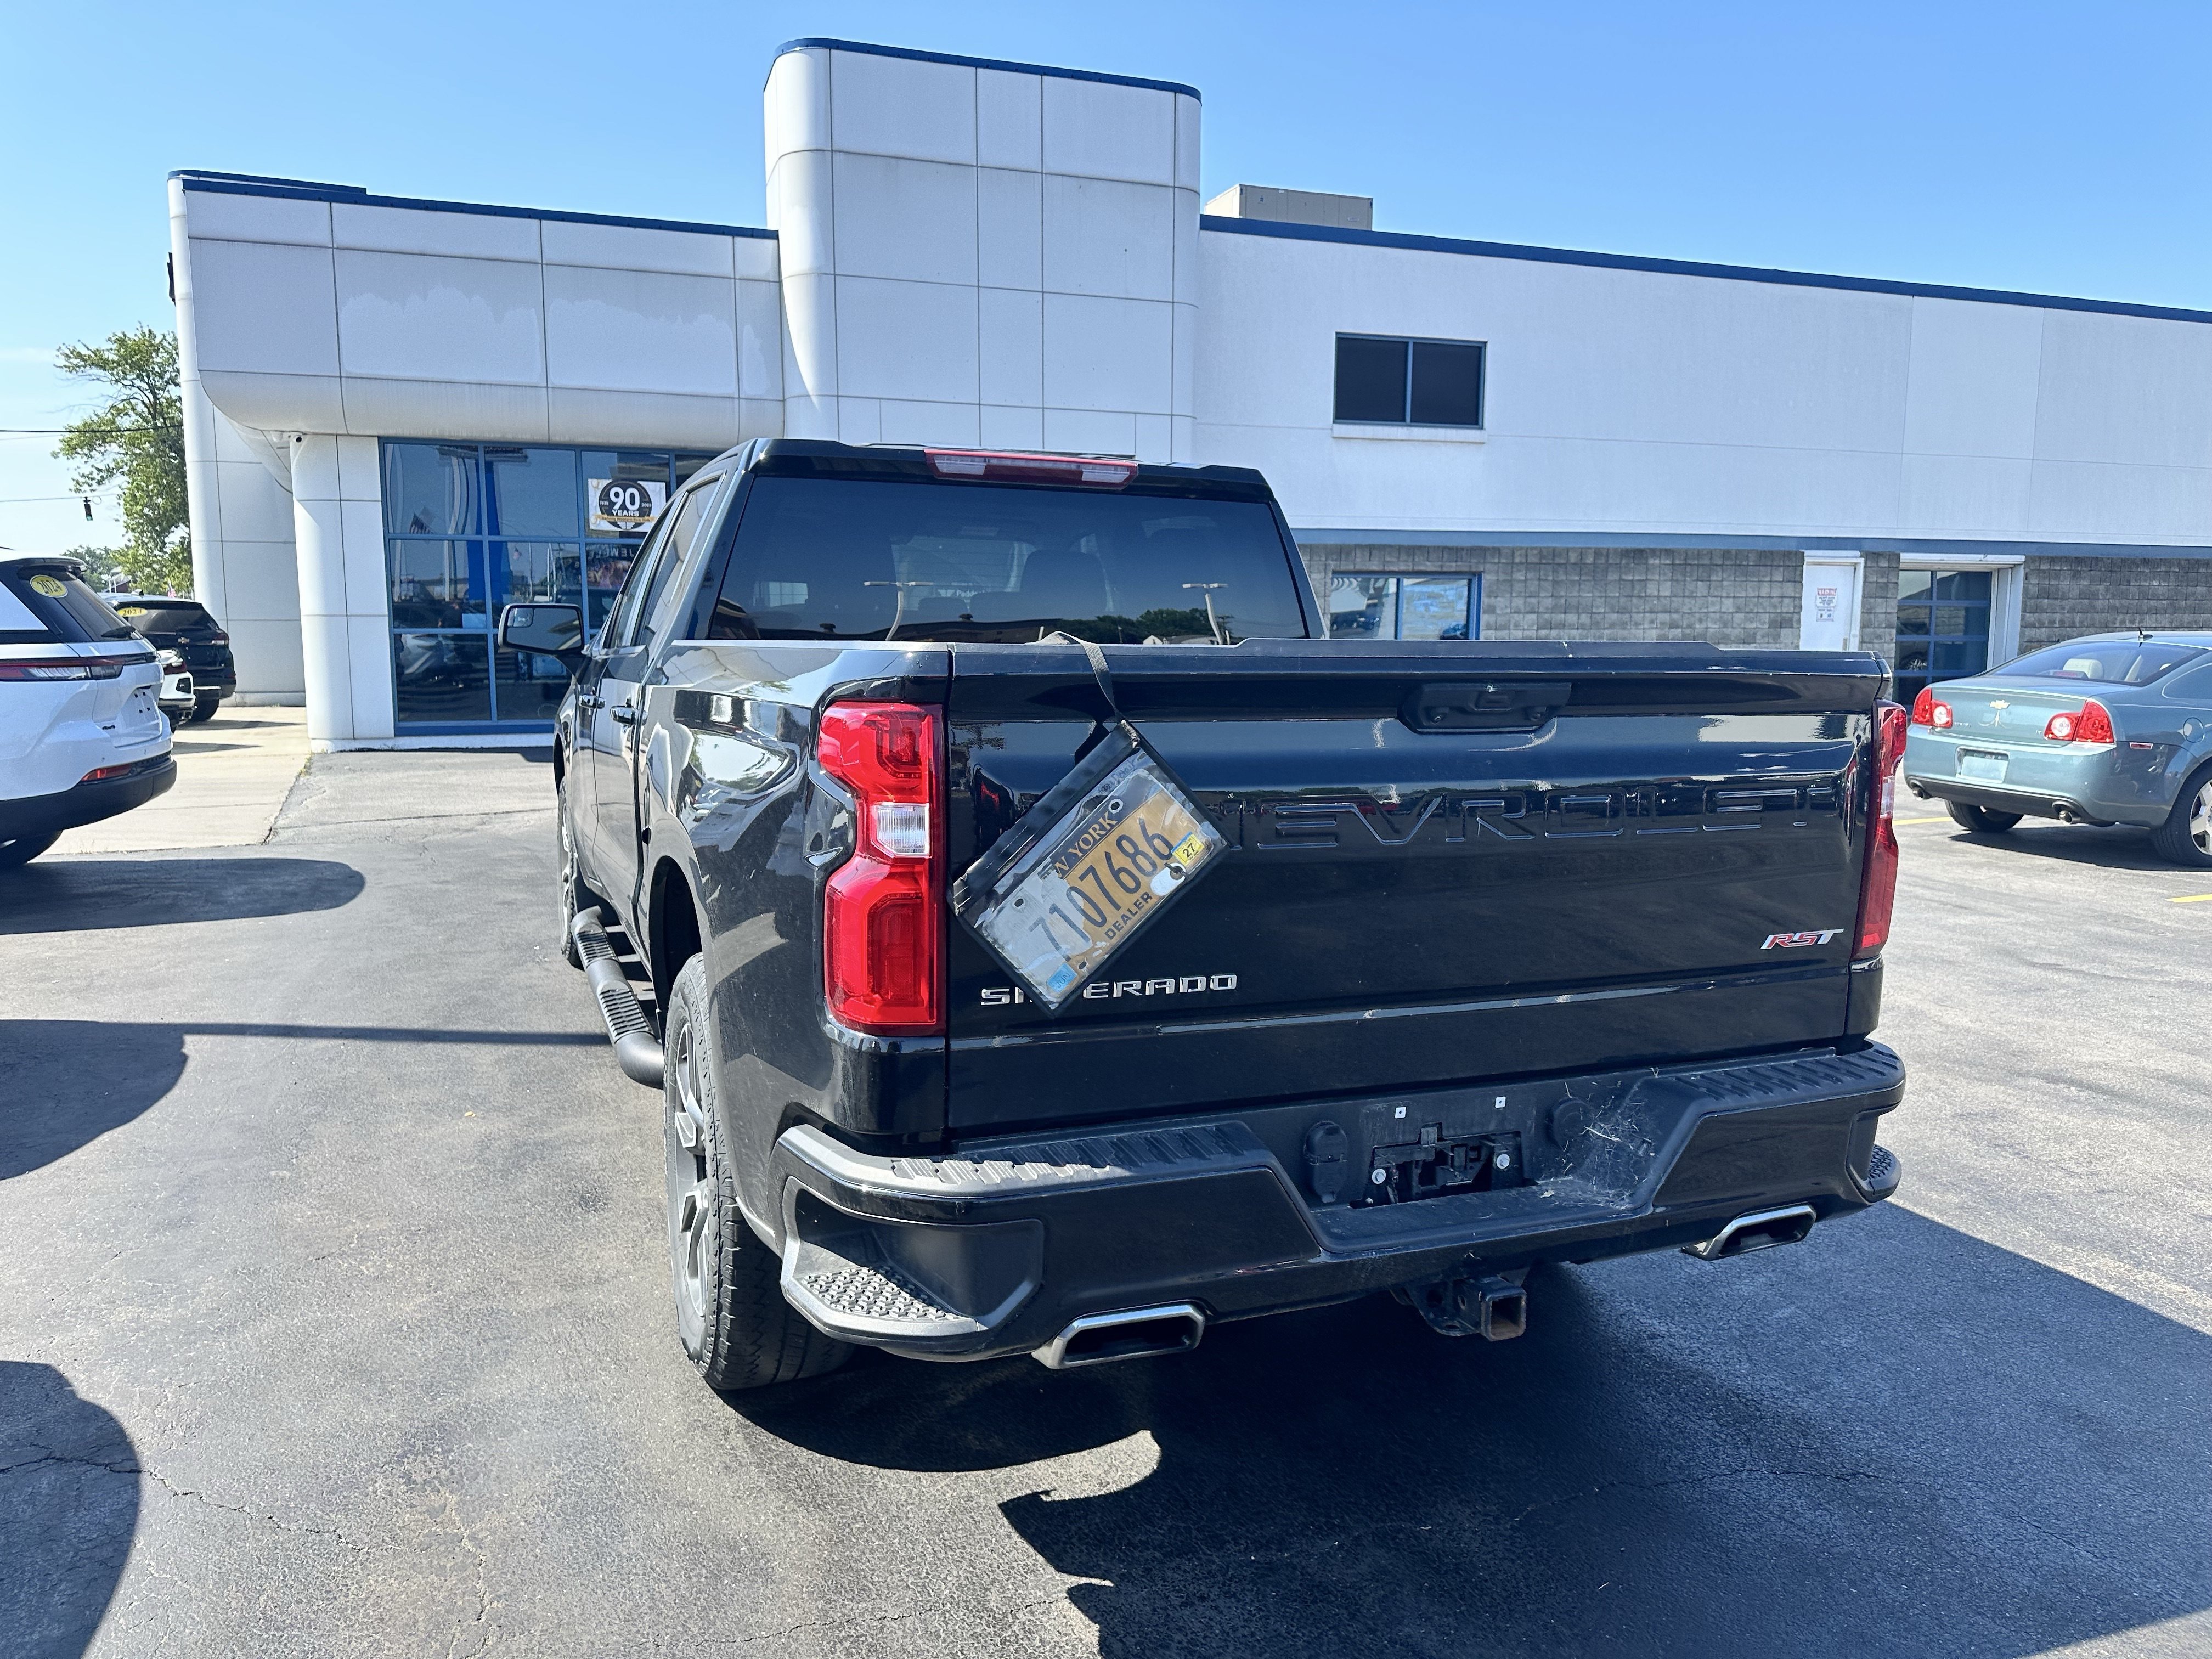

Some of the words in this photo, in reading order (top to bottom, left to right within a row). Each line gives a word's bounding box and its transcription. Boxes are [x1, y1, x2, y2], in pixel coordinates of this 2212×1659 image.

[610, 486, 640, 511] 90
[36, 579, 63, 594] 2024
[1219, 781, 1833, 850] EVROLET
[1068, 811, 1118, 858] YORK
[1182, 842, 1195, 859] 27
[1028, 817, 1174, 961] 7107686
[1104, 892, 1153, 941] DEALER
[1760, 928, 1844, 950] RST
[981, 974, 1237, 1006] SIERADO
[1056, 973, 1071, 989] JUN
